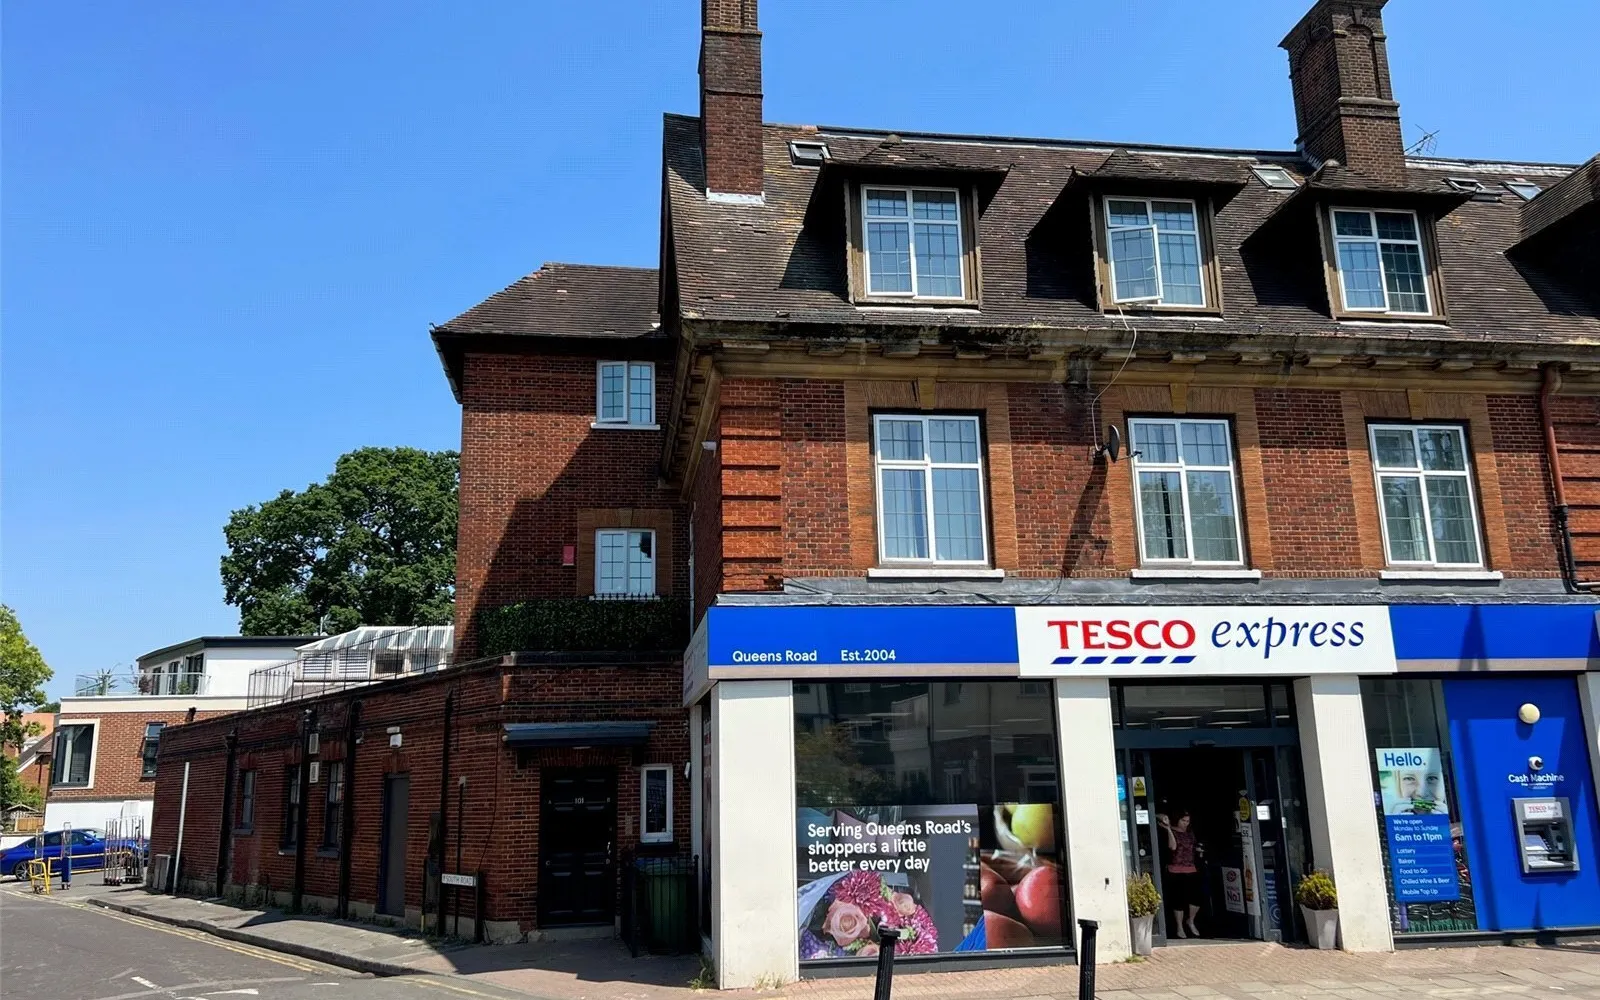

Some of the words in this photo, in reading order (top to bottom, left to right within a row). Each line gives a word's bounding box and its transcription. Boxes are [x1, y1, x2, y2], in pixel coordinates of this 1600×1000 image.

[1047, 620, 1196, 649] TESCO
[1211, 616, 1365, 659] express
[732, 650, 782, 662] Queens
[785, 650, 817, 661] Road
[841, 649, 896, 661] Est.2004
[1384, 752, 1426, 767] Hello.
[1508, 774, 1529, 782] Cash
[1530, 773, 1564, 782] Machine
[807, 823, 862, 839] Serving
[866, 822, 922, 836] Queens
[925, 820, 972, 834] Road's
[1423, 833, 1443, 842] 11pm
[808, 841, 877, 857] shoppers
[881, 842, 890, 852] a
[893, 838, 927, 852] little
[808, 859, 855, 872] better
[859, 858, 901, 873] every
[904, 856, 930, 872] day
